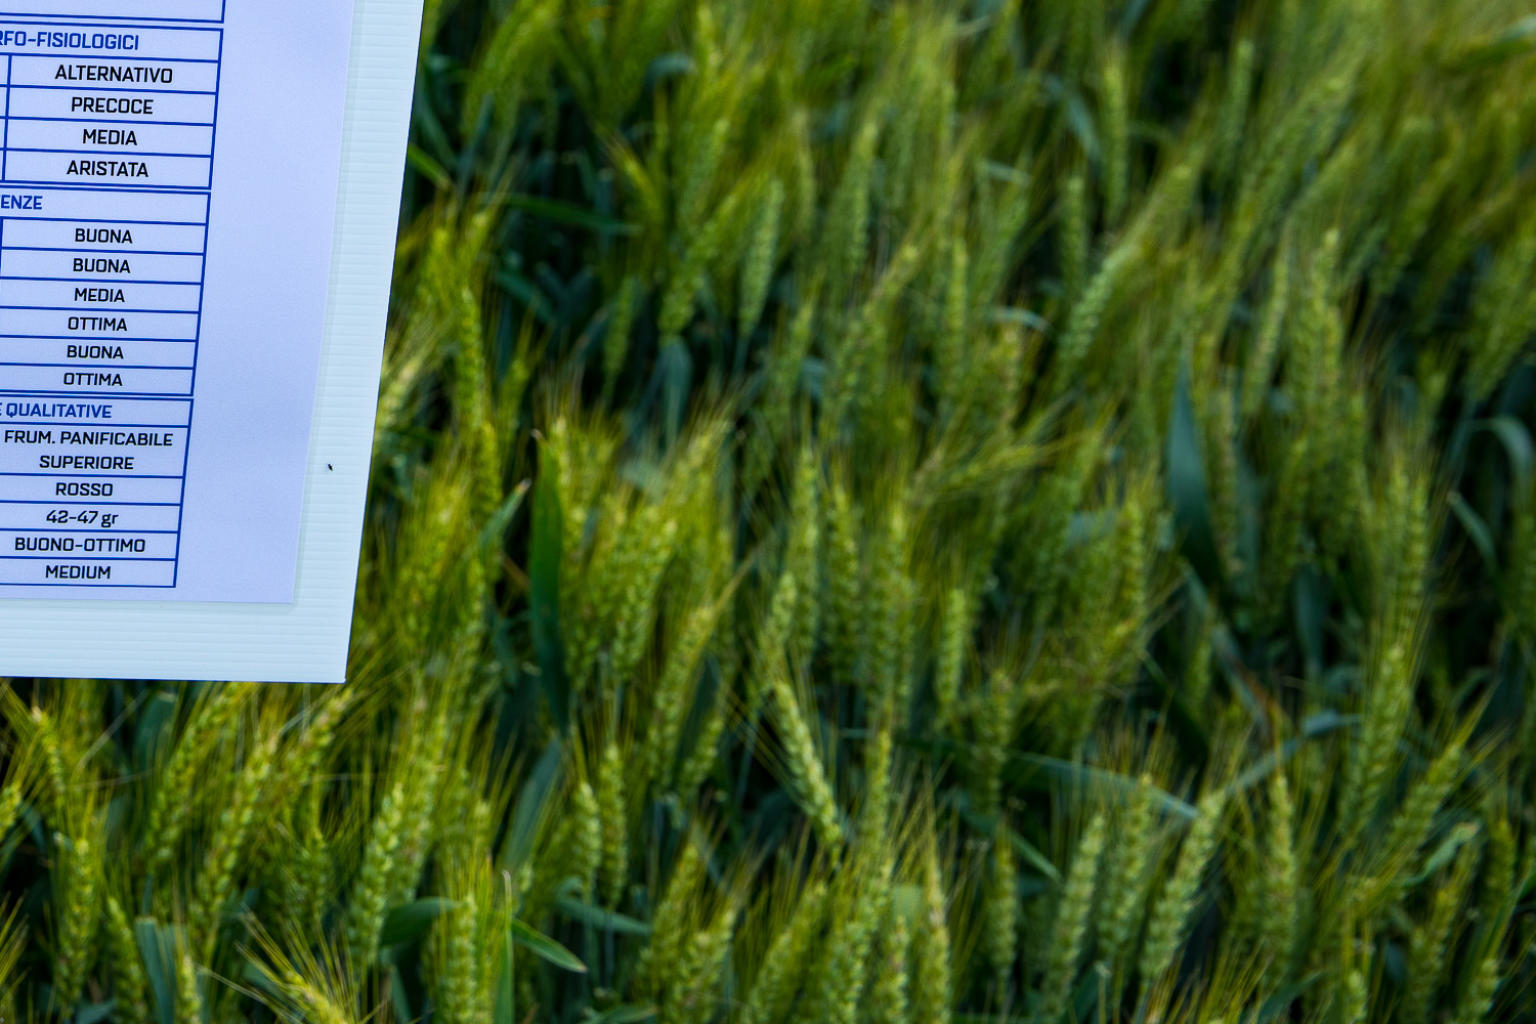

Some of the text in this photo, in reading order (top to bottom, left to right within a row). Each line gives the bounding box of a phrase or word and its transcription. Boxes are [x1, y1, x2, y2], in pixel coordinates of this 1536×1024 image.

[54, 64, 173, 84] ALTERNATIVO
[70, 96, 154, 115] PRECOCE
[82, 128, 138, 147] MEDIA
[66, 159, 149, 178] ARISTATA
[74, 228, 133, 245] BUONA
[72, 257, 131, 275] BUONA
[73, 287, 125, 304] MEDIA
[67, 316, 128, 333] OTTIMA
[66, 344, 124, 361] BUONA
[63, 371, 123, 388] OTTIMA
[5, 402, 112, 421] QUALITATIVE
[4, 429, 173, 448] FRUM. PANIFICABILE
[39, 454, 135, 472] SUPERIORE
[55, 482, 114, 498] ROSSO
[45, 509, 119, 528] 42-47 gr
[14, 537, 146, 554] BUONO-OTTIMO
[45, 564, 112, 581] MEDIUM
